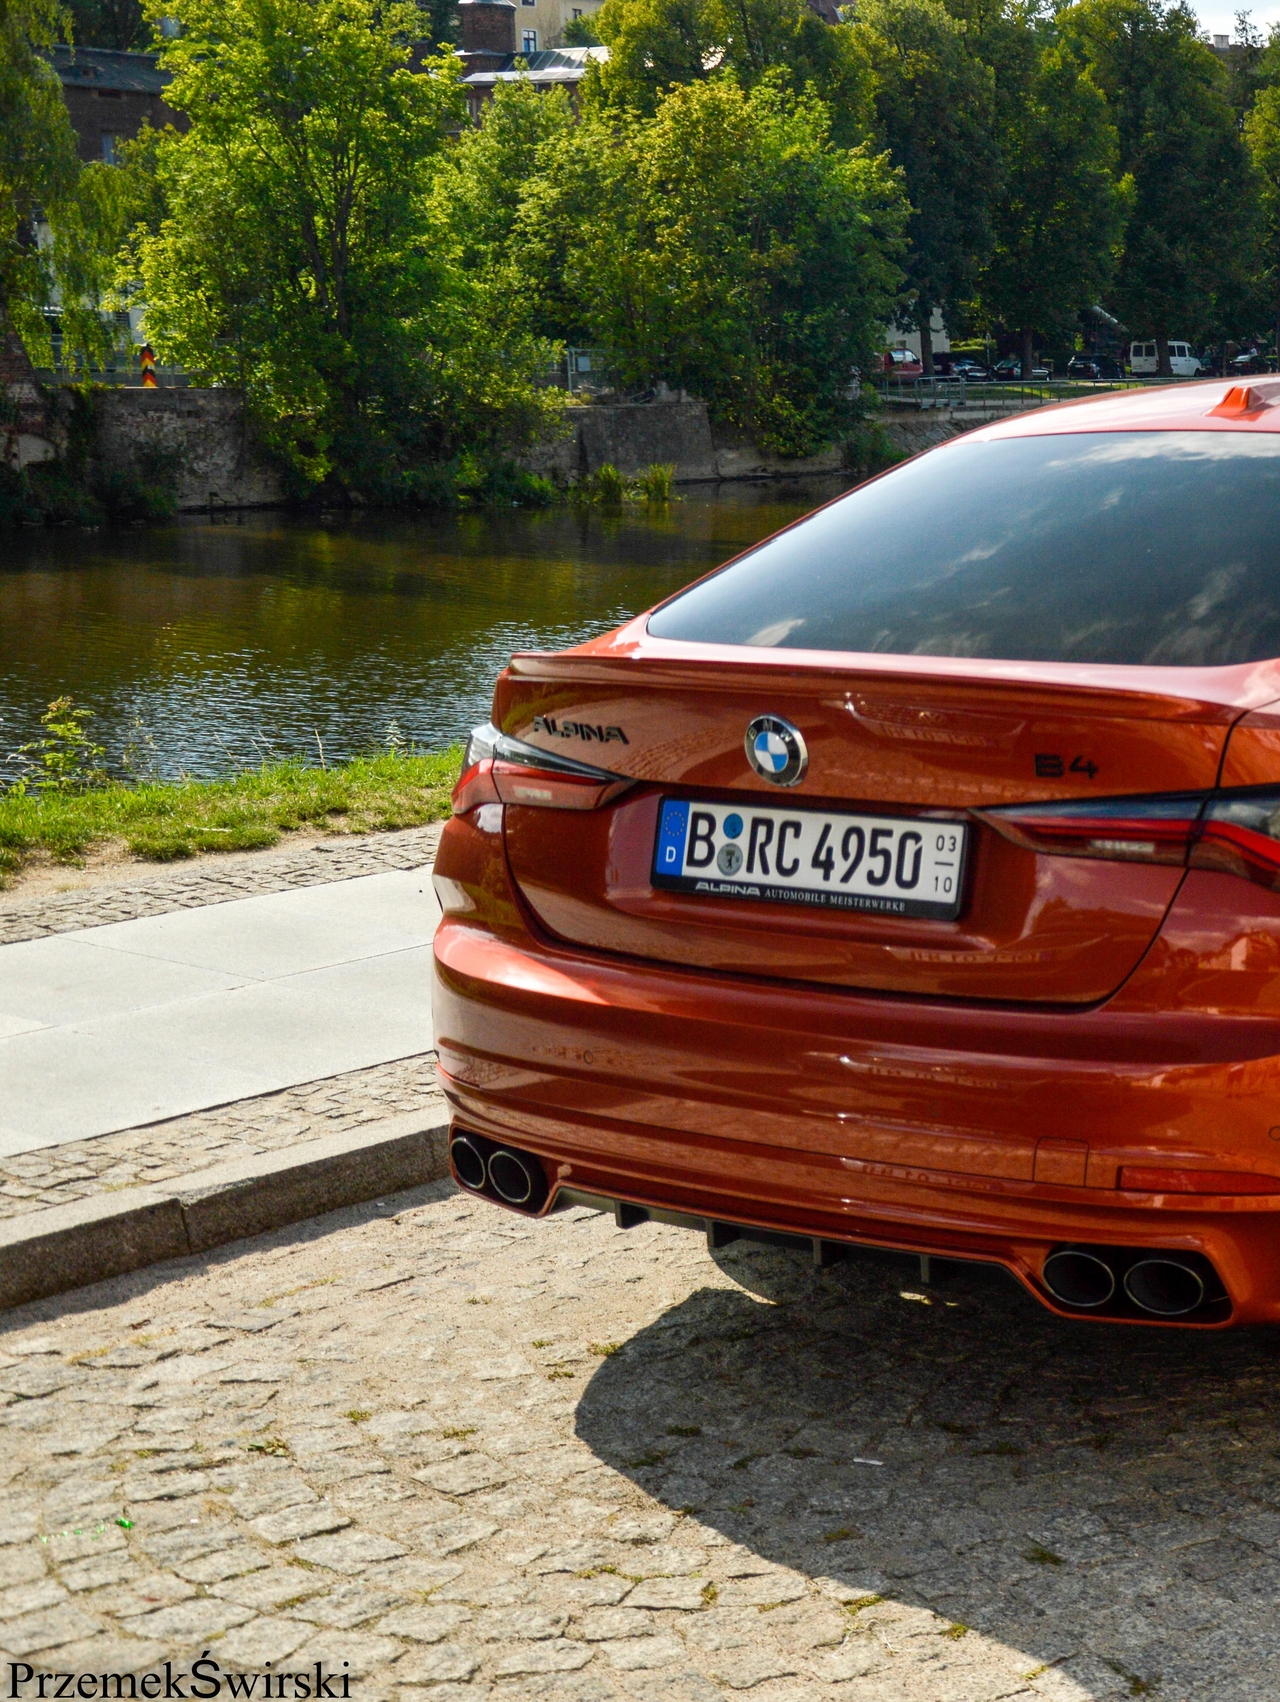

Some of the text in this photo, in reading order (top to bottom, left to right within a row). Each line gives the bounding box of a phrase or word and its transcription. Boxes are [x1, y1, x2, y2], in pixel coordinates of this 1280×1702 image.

[533, 715, 630, 745] ALPINA
[748, 719, 793, 743] BMW
[1034, 754, 1099, 779] B4
[665, 846, 676, 863] D
[686, 811, 923, 890] B RC 4950
[935, 834, 957, 853] 03
[695, 881, 905, 912] ALPINA AUTOMOBILE MEISTERWERKE
[934, 876, 952, 893] 10
